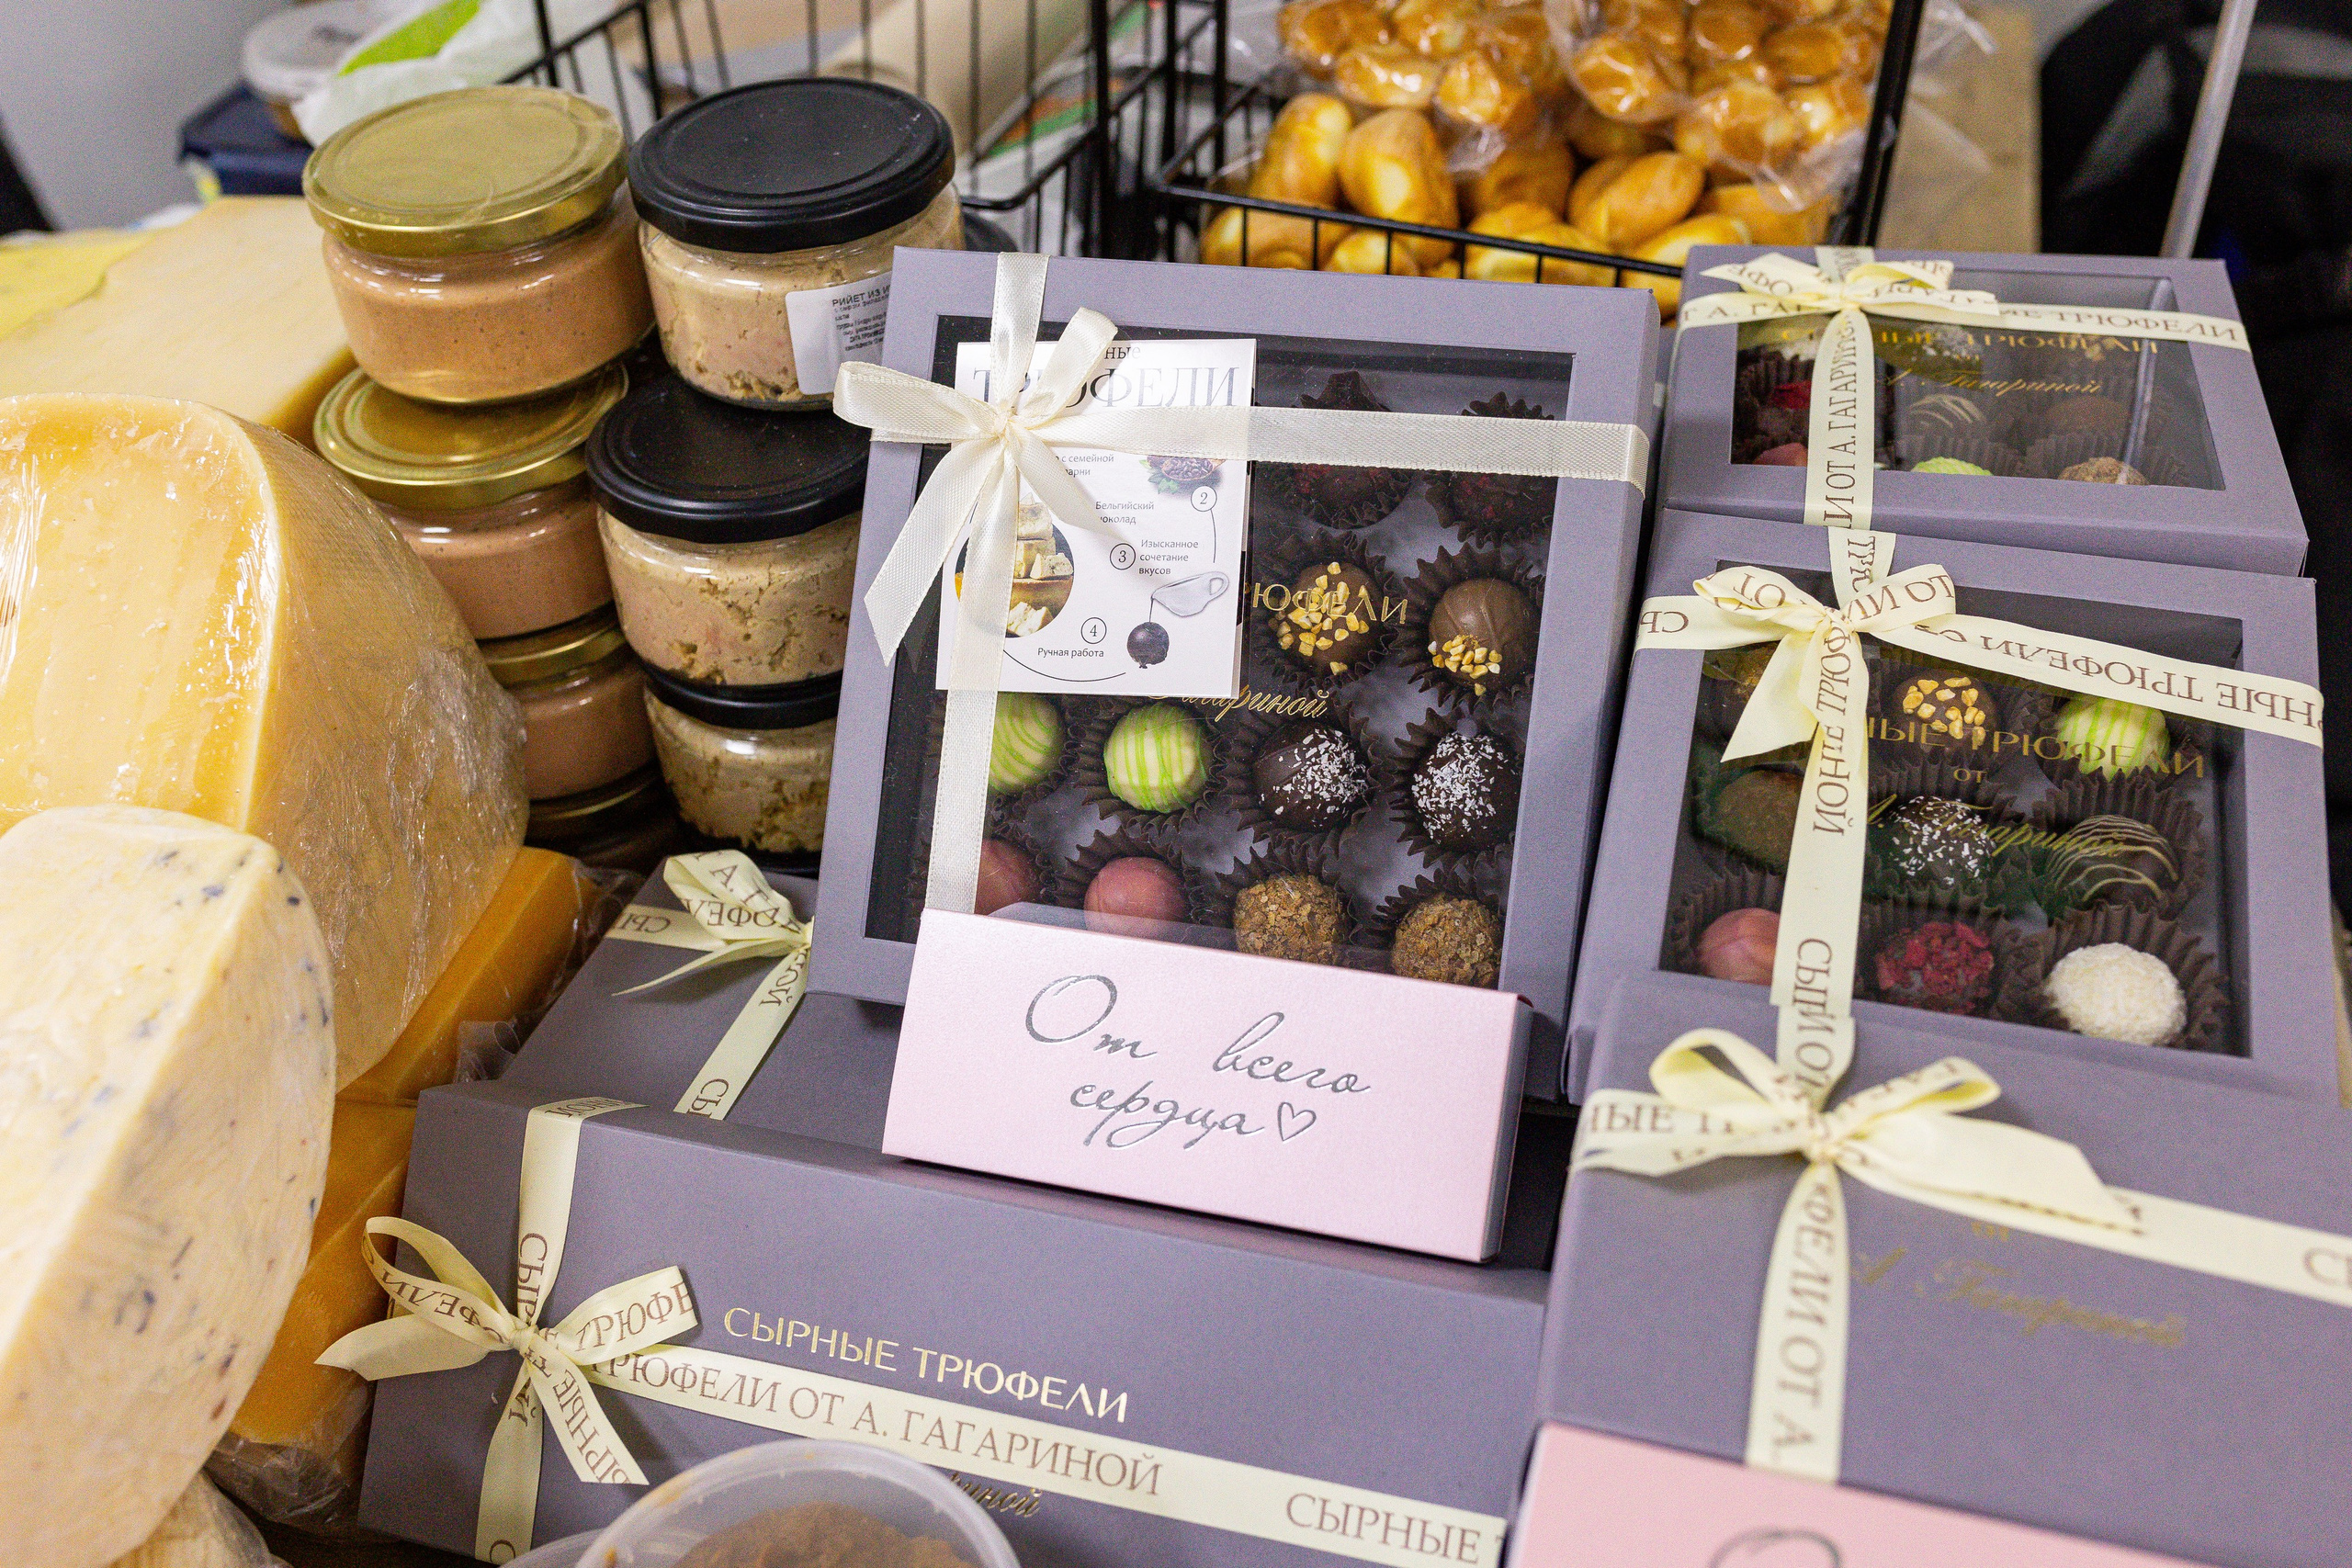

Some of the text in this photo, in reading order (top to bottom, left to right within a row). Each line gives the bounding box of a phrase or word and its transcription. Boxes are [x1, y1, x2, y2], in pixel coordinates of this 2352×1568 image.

[832, 291, 865, 307] РИЙЕТ
[2052, 310, 2238, 343] ТРЮФЕЛИ
[1069, 454, 1114, 462] семейной
[1826, 460, 1856, 490] ОТ
[1199, 492, 1209, 505] 2
[1095, 501, 1155, 511] Бельгийский
[1140, 539, 1199, 548] Изысканное
[1118, 550, 1127, 563] 3
[1139, 554, 1189, 562] сочетание
[1138, 567, 1171, 576] вкусов
[1089, 625, 1098, 637] 4
[1037, 647, 1104, 659] Ручная работа
[1980, 635, 2205, 704] ТРЮФЕЛИ
[1024, 974, 1371, 1094] От всего
[1069, 1080, 1265, 1150] сердца
[723, 1306, 1129, 1423] СЫРНЫЕ ТРЮФЕЛИ
[788, 1387, 844, 1426] ОТ
[850, 1401, 888, 1438] А.
[899, 1409, 1163, 1497] ГАГАРИНОЙ
[1285, 1492, 1482, 1565] СЫРНЫЕ
